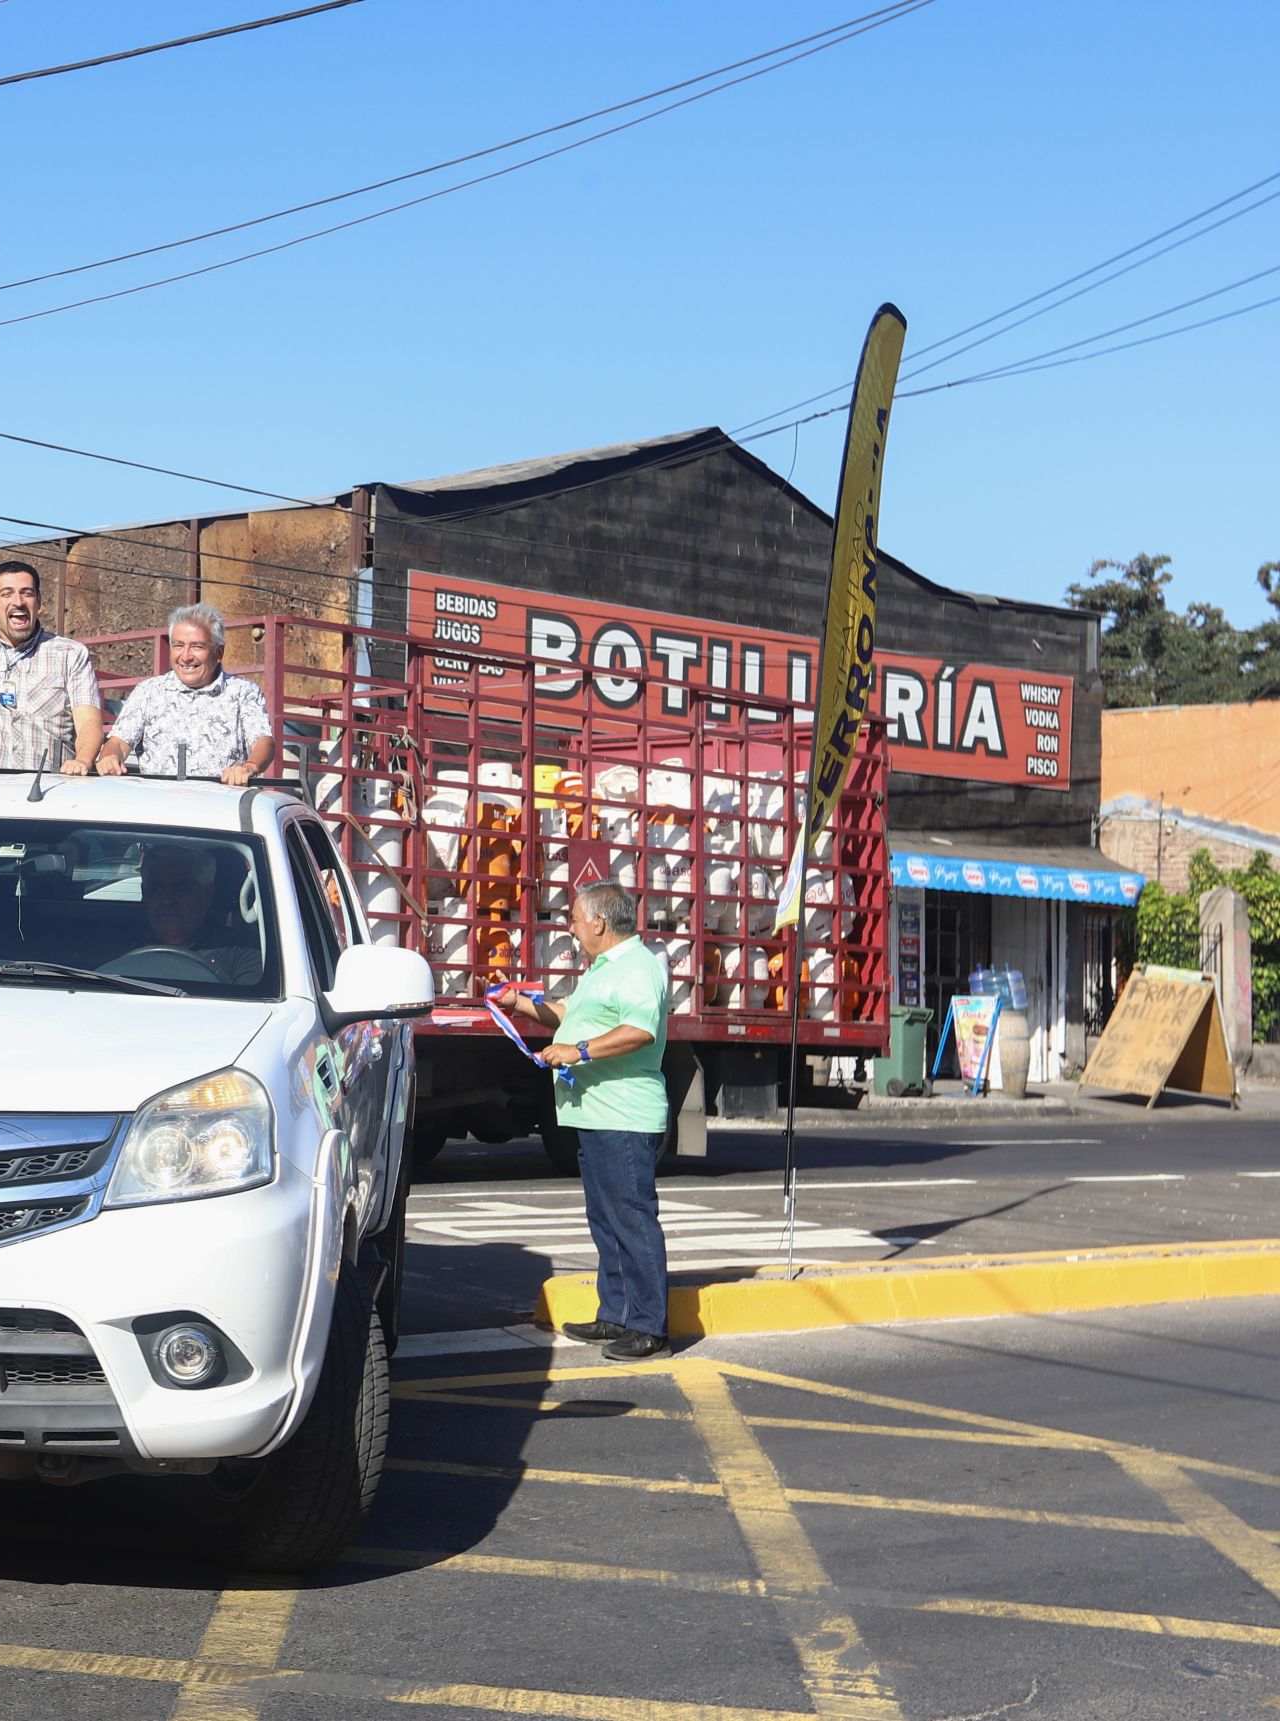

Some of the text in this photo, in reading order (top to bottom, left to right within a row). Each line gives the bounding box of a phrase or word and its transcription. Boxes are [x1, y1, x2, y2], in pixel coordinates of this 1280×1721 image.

[435, 591, 498, 620] BEBIDAS
[434, 618, 482, 646] JUGOS
[433, 646, 506, 677] CERVZAS
[528, 609, 1006, 758] BOTILLRÍA
[1020, 683, 1061, 707] WHISKY
[1025, 707, 1060, 731] VODKA
[1037, 733, 1059, 754] RON
[1027, 756, 1058, 778] PISCO
[1126, 976, 1204, 1007] PROMO
